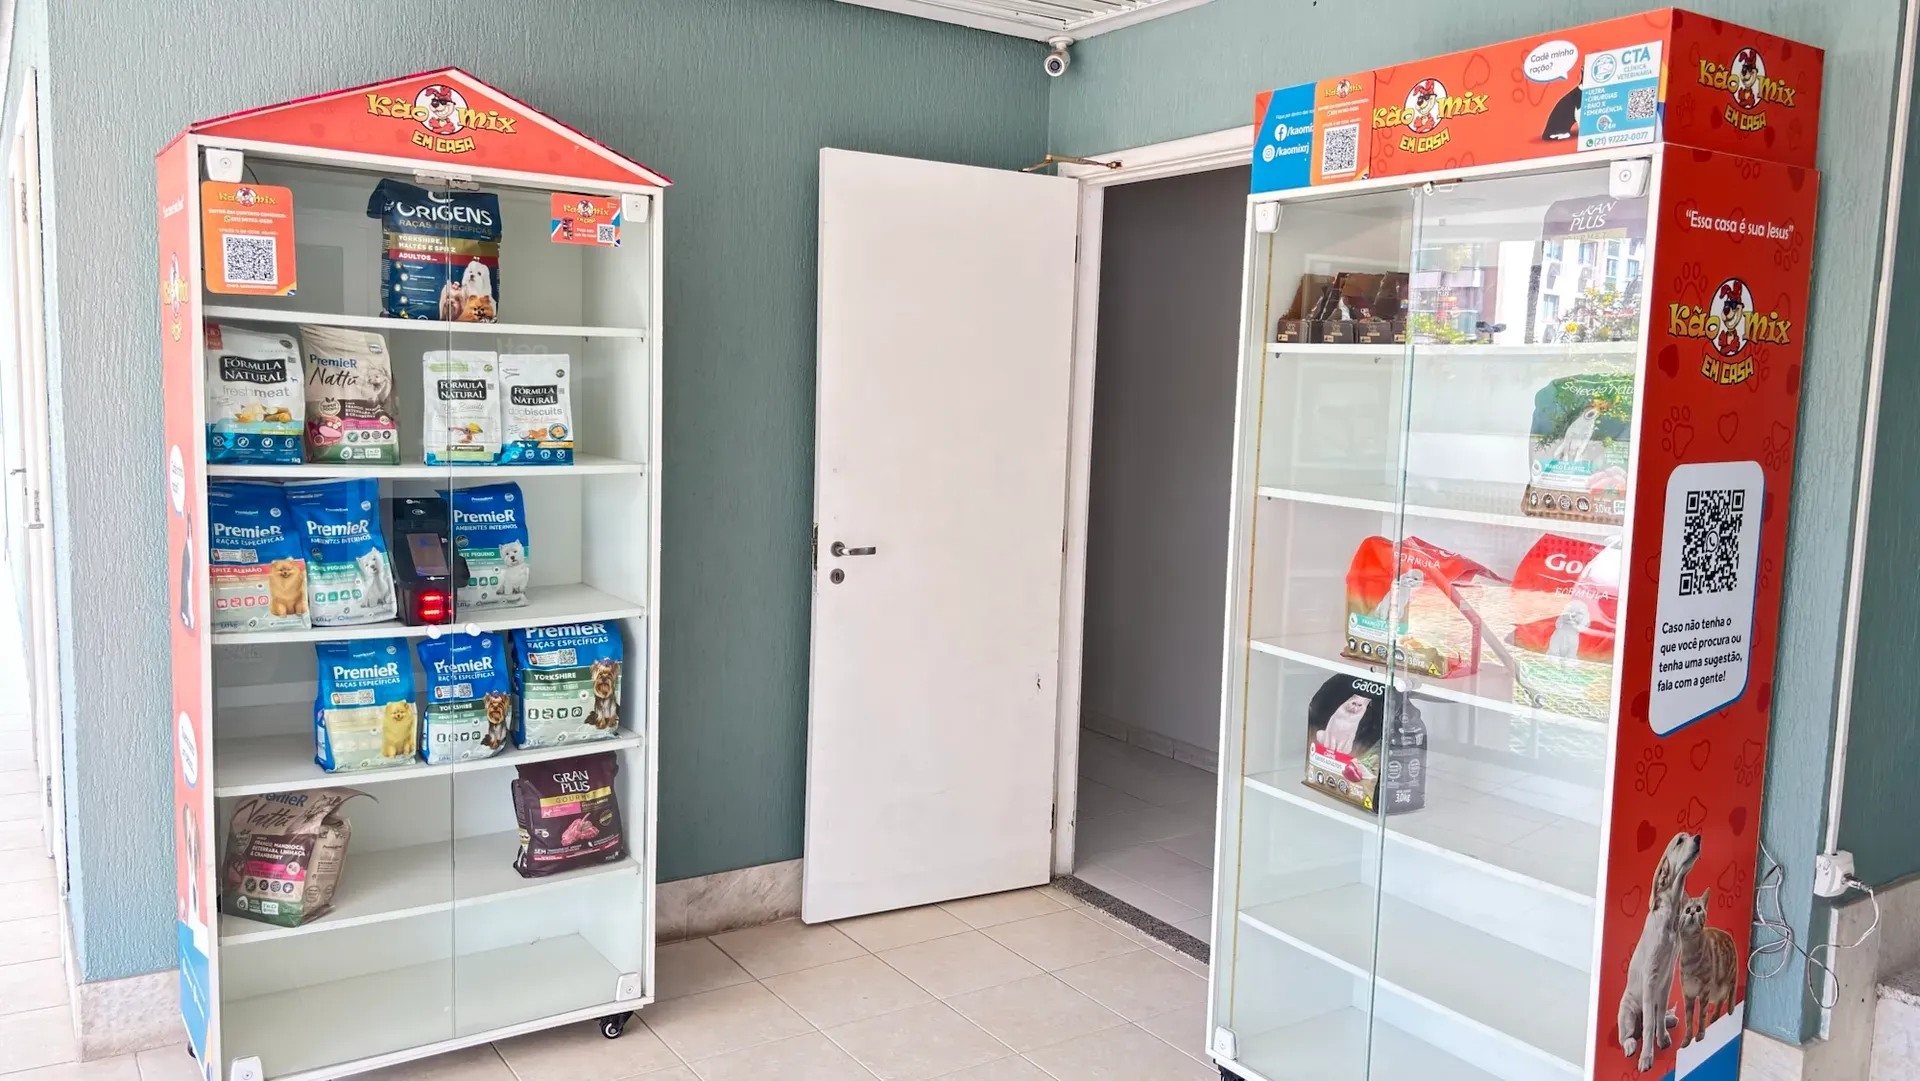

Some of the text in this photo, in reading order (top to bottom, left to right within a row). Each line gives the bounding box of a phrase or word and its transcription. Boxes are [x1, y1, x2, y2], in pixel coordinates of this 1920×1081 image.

[1531, 47, 1575, 63] Cadê minha
[1622, 47, 1650, 64] CTA
[1530, 62, 1554, 74] ração?
[1699, 59, 1738, 95] Kão
[366, 93, 429, 122] Kão
[1373, 107, 1415, 131] Kão
[1724, 106, 1767, 132] EM CASA
[411, 129, 475, 154] EM CASA
[1399, 127, 1451, 153] EM CASA
[1594, 132, 1648, 147] (21) 97222-0077
[396, 202, 492, 226] ORIGENS
[400, 220, 432, 229] RAÇAS
[1570, 214, 1607, 231] PLUS
[1714, 218, 1736, 233] casa
[1739, 218, 1745, 234] é
[1748, 223, 1764, 237] sua
[398, 252, 431, 260] ADULTOS
[1668, 303, 1721, 340] Kão
[224, 357, 282, 371] FÓRMULA
[1701, 355, 1754, 385] EM CASA
[225, 370, 284, 382] NATURAL
[223, 385, 290, 397] freshmeat
[440, 380, 484, 389] FÓRMULA
[514, 385, 555, 395] FÓRMULA
[441, 389, 484, 399] NATURAL
[513, 396, 556, 404] NATURAL
[1394, 552, 1440, 568] FORMULA
[1555, 587, 1608, 600] FORMULA
[1662, 616, 1732, 634] Caso não tenha o
[527, 636, 608, 649] RAÇAS ESPECÍFICAS
[1660, 634, 1742, 656] que você procura ou
[1659, 651, 1743, 673] tenha uma sugestão,
[336, 677, 400, 689] RAÇAS ESPECÍFICAS
[459, 671, 495, 680] ESPECÍFICAS
[534, 672, 576, 680] YORKSHIRE
[1657, 670, 1726, 692] fala com a gente!
[553, 770, 589, 783] GRAN
[561, 781, 590, 793] PLUS
